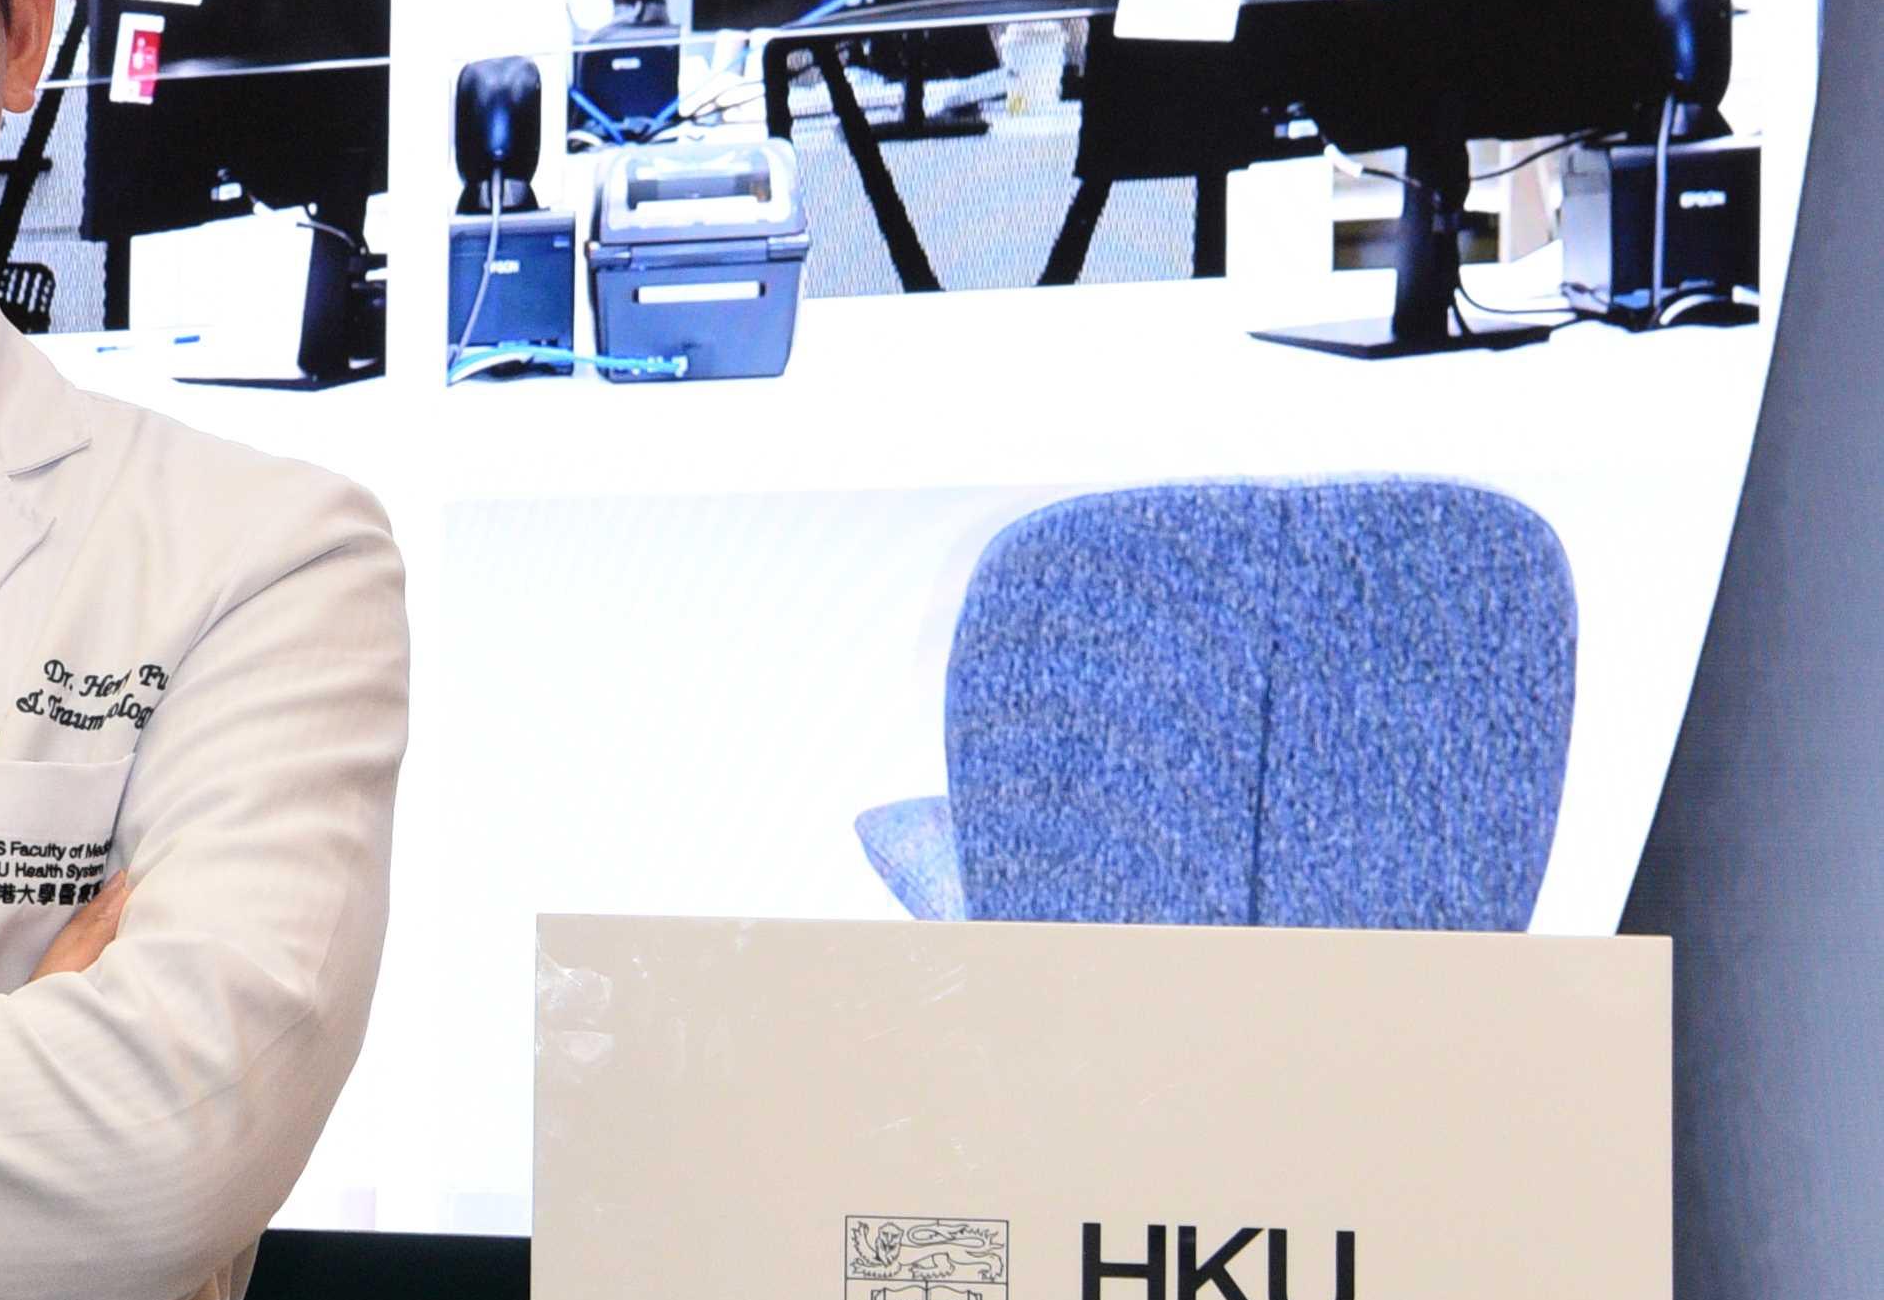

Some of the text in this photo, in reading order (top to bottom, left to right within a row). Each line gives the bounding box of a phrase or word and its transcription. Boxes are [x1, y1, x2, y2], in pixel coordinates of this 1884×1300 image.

[43, 659, 74, 691] Dr.
[139, 664, 169, 691] Fu
[10, 841, 67, 860] Faculty
[69, 844, 84, 859] of
[15, 862, 63, 878] Health
